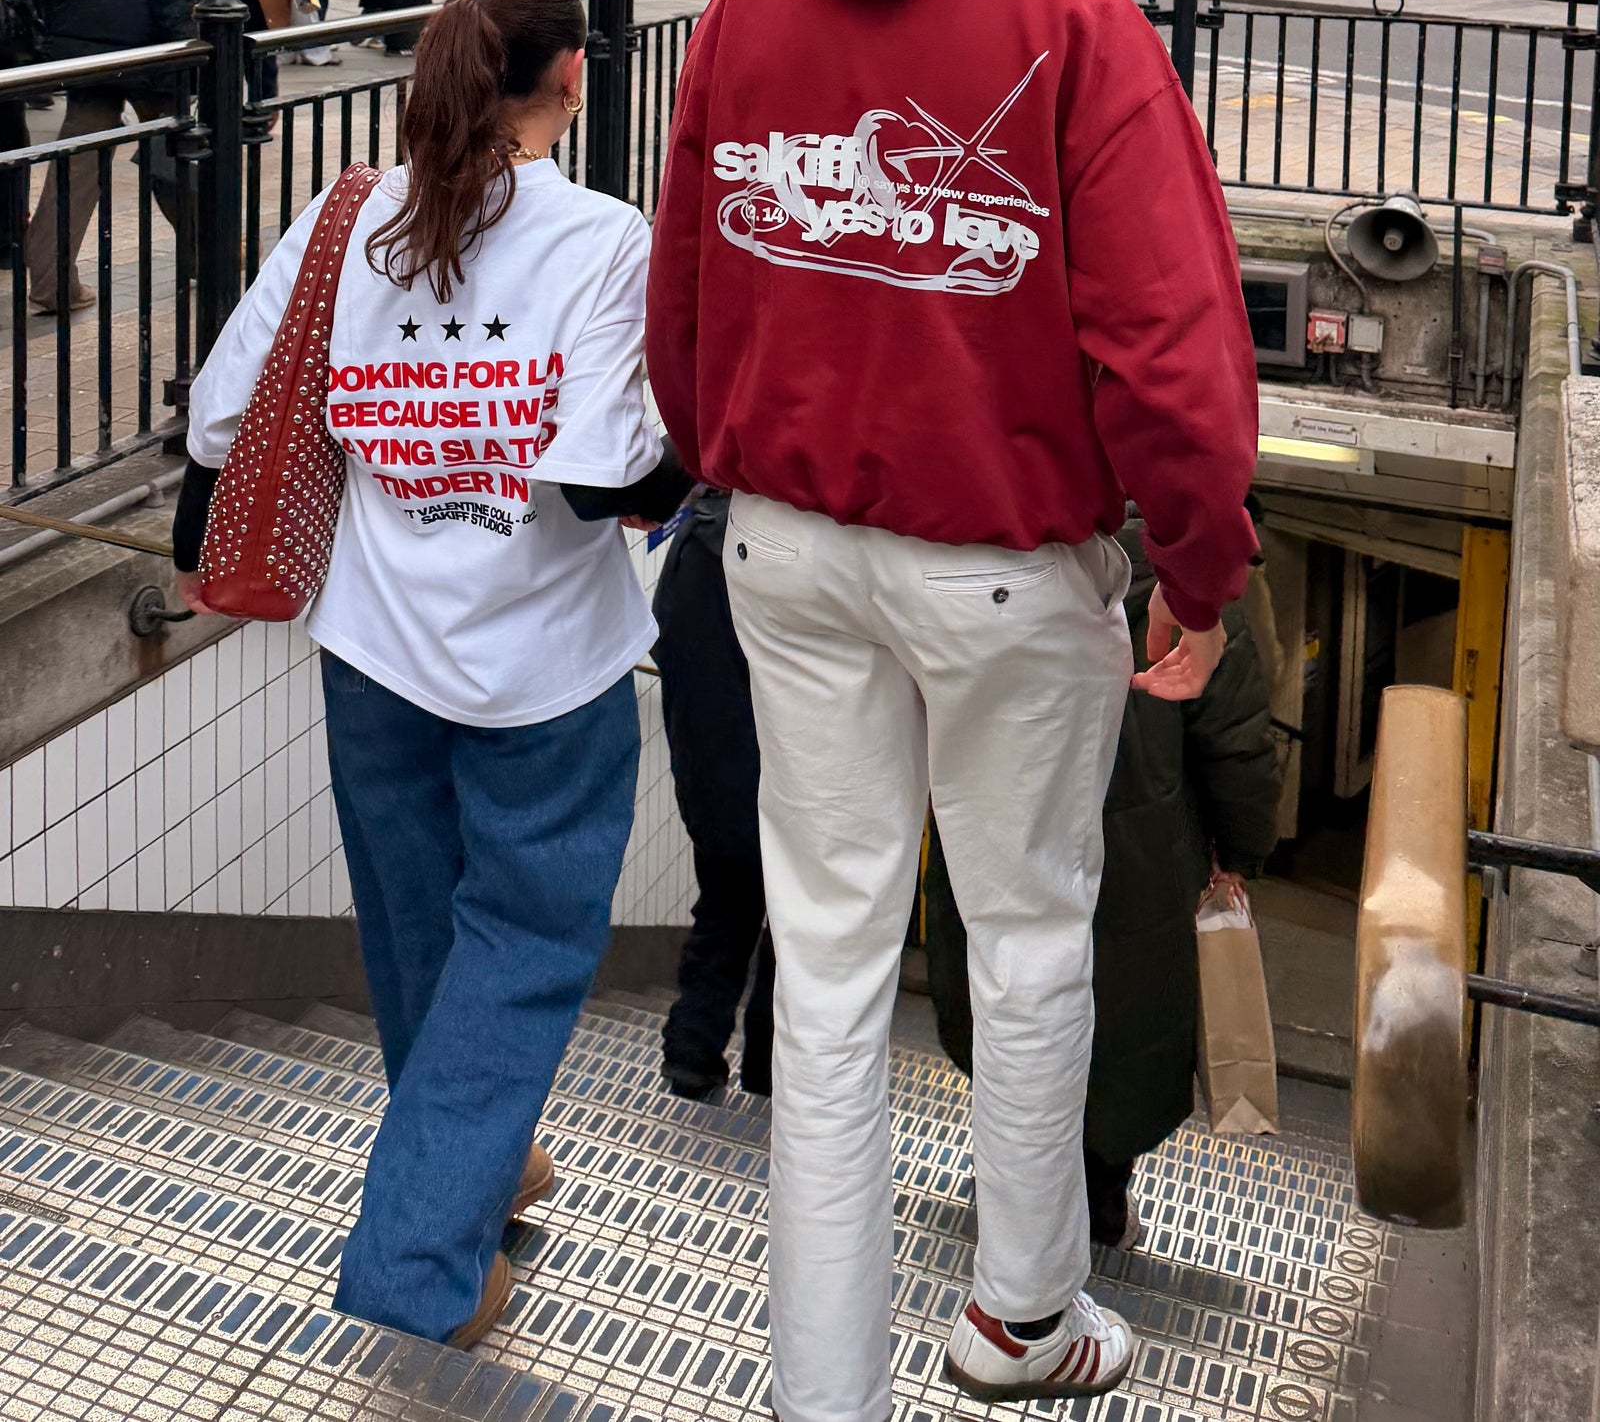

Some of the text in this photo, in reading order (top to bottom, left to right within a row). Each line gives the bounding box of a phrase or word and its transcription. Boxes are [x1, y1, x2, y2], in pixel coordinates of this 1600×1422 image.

[713, 131, 863, 190] sakiff
[932, 186, 964, 200] new
[967, 190, 1050, 218] experiences
[801, 198, 886, 242] yes
[943, 203, 1040, 260] love
[452, 360, 520, 389] FOR
[329, 399, 482, 429] BECAUSE
[487, 399, 498, 427] I
[443, 438, 476, 466] SI
[371, 471, 496, 500] TINDER
[416, 501, 490, 517] VALENTINE
[490, 507, 514, 525] COLL
[421, 510, 513, 537] SAKIFF STUDIOS
